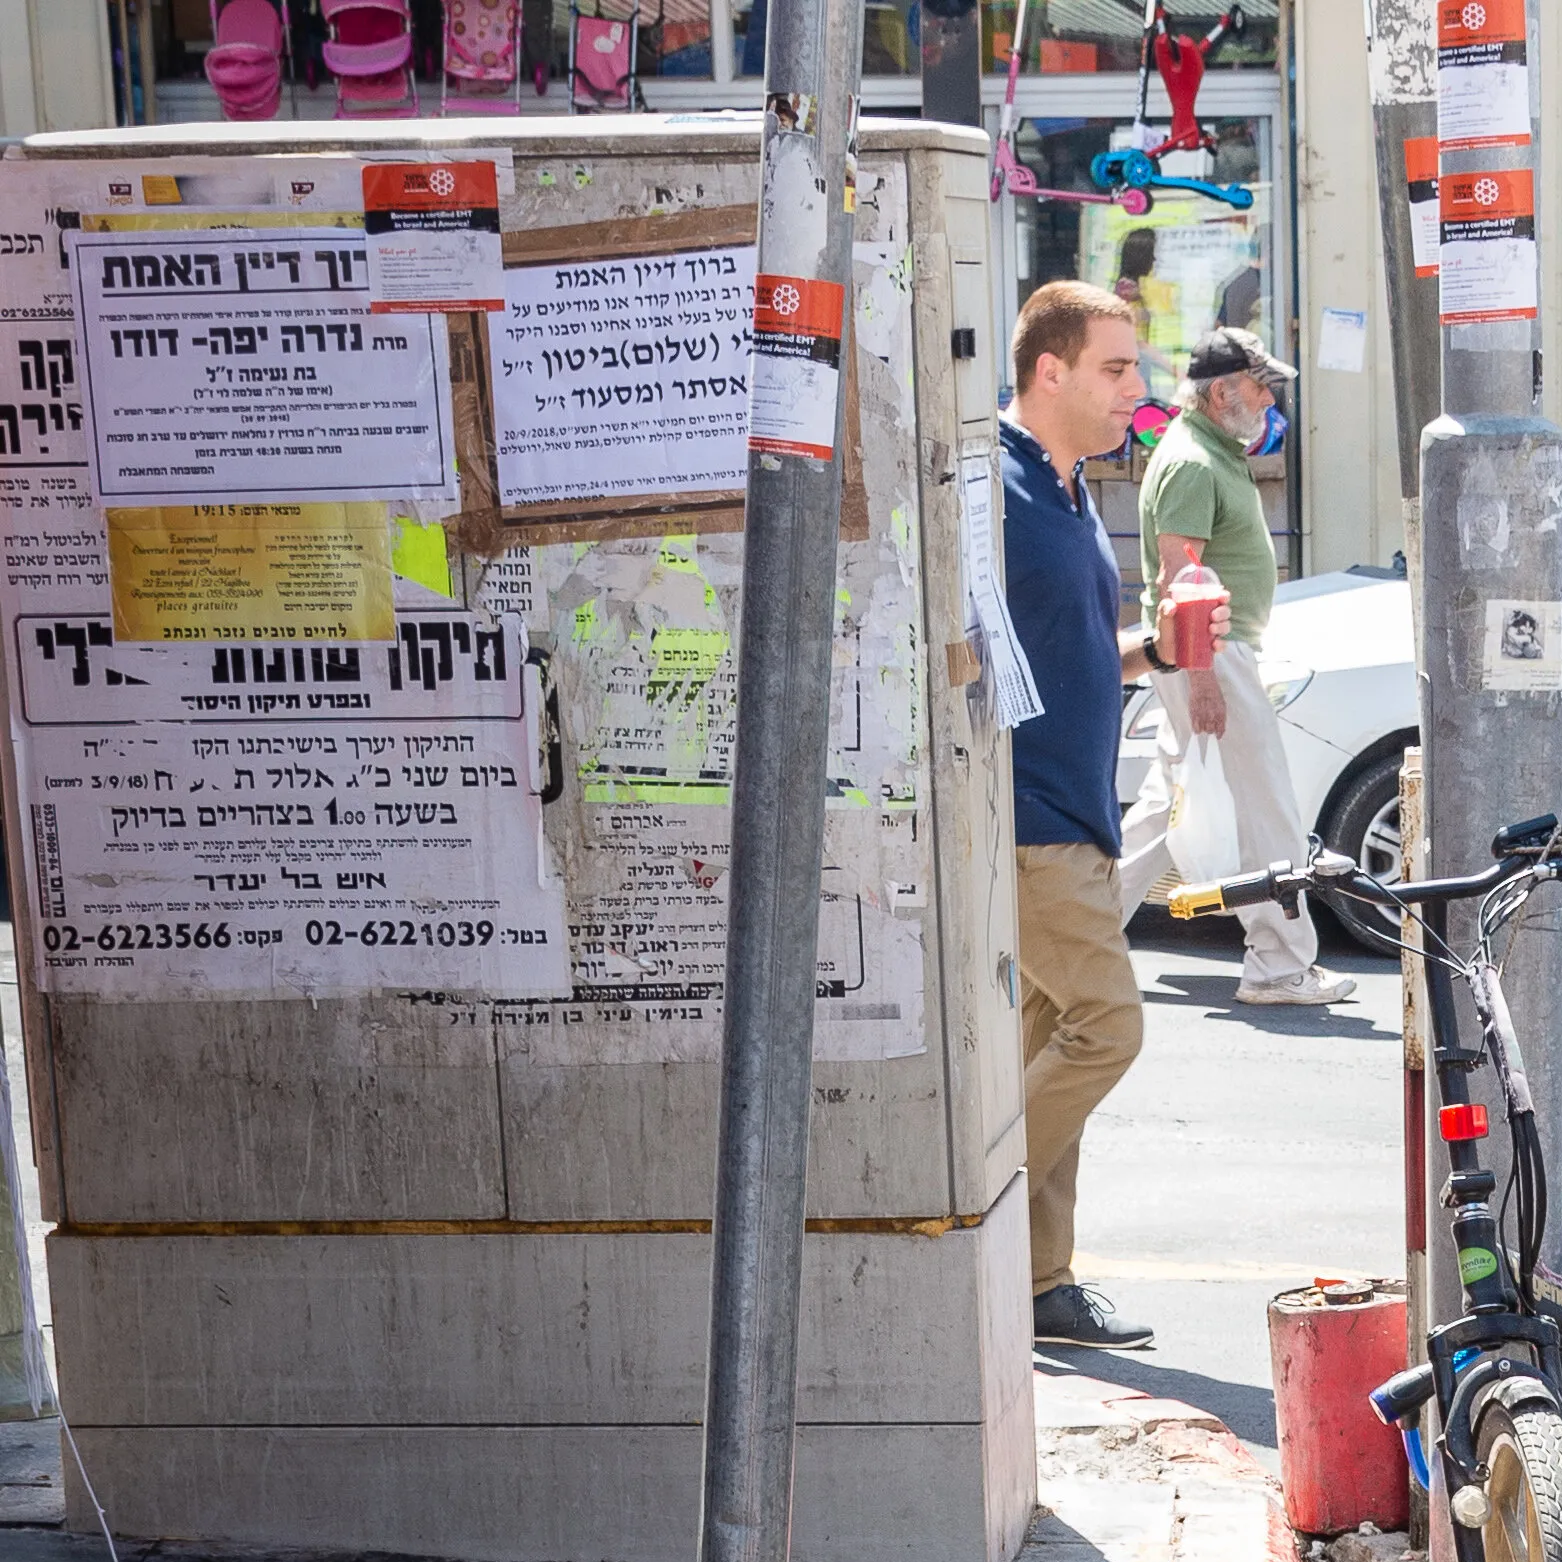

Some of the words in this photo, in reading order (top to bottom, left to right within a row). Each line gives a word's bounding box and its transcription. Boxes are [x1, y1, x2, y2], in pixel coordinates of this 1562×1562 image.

[101, 252, 222, 290] האמת
[234, 250, 302, 292] דיין
[555, 265, 626, 290] האמת
[634, 260, 677, 288] דיין
[684, 255, 738, 283] ברוך
[635, 293, 671, 309] קודר
[722, 287, 741, 300] רב
[511, 302, 532, 319] על
[536, 299, 600, 317] מודיעים
[604, 297, 630, 310] אנו
[636, 315, 674, 331] אבינו
[678, 311, 711, 327] בעלי
[715, 307, 738, 323] של
[506, 326, 544, 343] היקר
[591, 319, 632, 333] אחינו
[110, 328, 180, 359] דודו
[281, 323, 364, 355] נדרה
[372, 335, 409, 351] מרת
[238, 366, 290, 383] נעימה
[294, 366, 318, 382] בת
[572, 381, 664, 409] ומסעוד
[672, 373, 748, 401] אסתר
[191, 504, 237, 517] 19:15
[6, 553, 49, 567] שאינם
[53, 553, 101, 567] השבים
[8, 573, 52, 590] הקודש
[56, 573, 82, 586] רוח
[163, 626, 206, 638] ונכתב
[212, 626, 245, 638] נזכר
[252, 626, 296, 638] טובים
[246, 693, 301, 714] תיקון
[306, 693, 372, 710] ובפרט
[346, 735, 396, 760] יערך
[403, 735, 475, 760] התיקון
[265, 761, 335, 790] אלול
[402, 765, 450, 789] שני
[461, 765, 518, 788] ביום
[196, 802, 315, 828] בצהריים
[323, 797, 366, 826] 1.00
[374, 801, 458, 827] בשעה
[111, 805, 187, 838] בדיוק
[281, 866, 323, 890] בל
[627, 862, 676, 877] העליה
[193, 872, 267, 892] יעדר
[336, 871, 388, 890] איש
[42, 921, 233, 952] 02-6223566
[237, 928, 284, 949] פקס:
[304, 919, 495, 948] 02-6221039
[500, 927, 549, 946] בטל:
